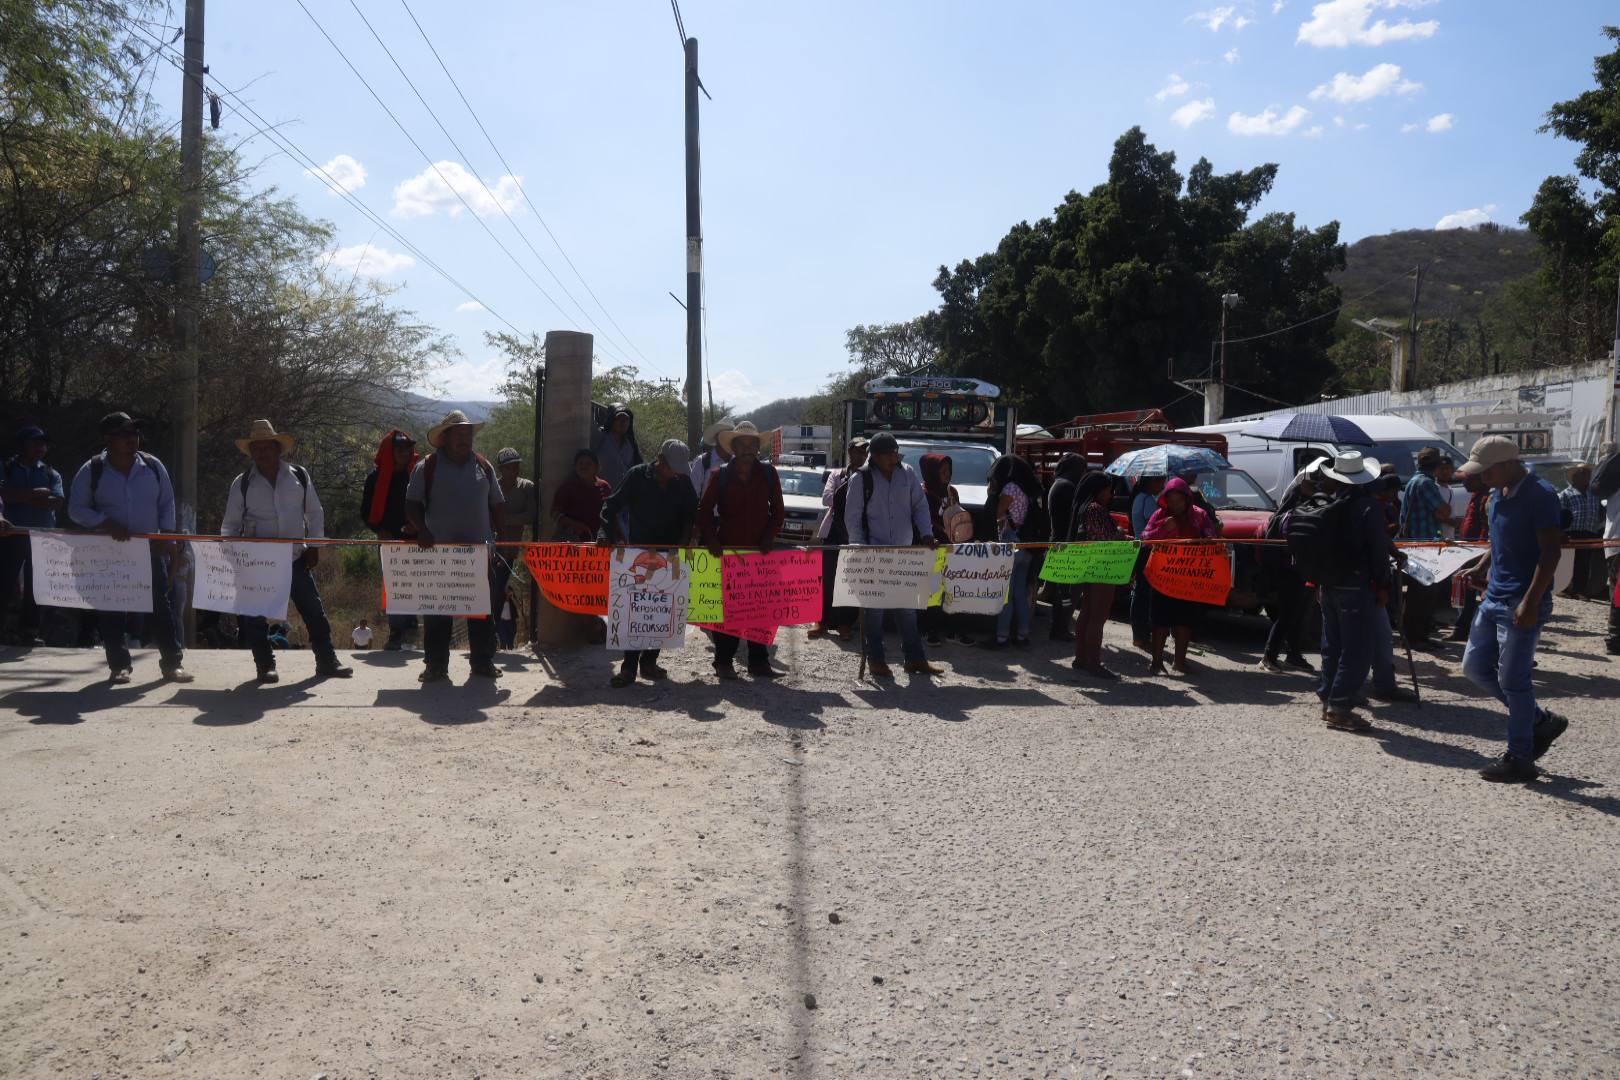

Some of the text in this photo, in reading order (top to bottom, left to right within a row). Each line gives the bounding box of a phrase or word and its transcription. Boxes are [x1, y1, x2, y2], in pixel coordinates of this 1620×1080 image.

[911, 379, 950, 388] NP300
[955, 544, 1013, 558] ZONA 078
[684, 551, 708, 574] NO
[724, 557, 736, 568] No
[559, 572, 605, 584] DERECHO
[1160, 566, 1216, 579] NOVIEMBRE
[633, 592, 668, 602] EXIGE
[729, 591, 746, 600] NOS
[748, 589, 780, 600] FALTAN
[565, 594, 608, 608] ESCOLAR
[772, 605, 800, 620] 078
[630, 622, 670, 633] RECURSOS
